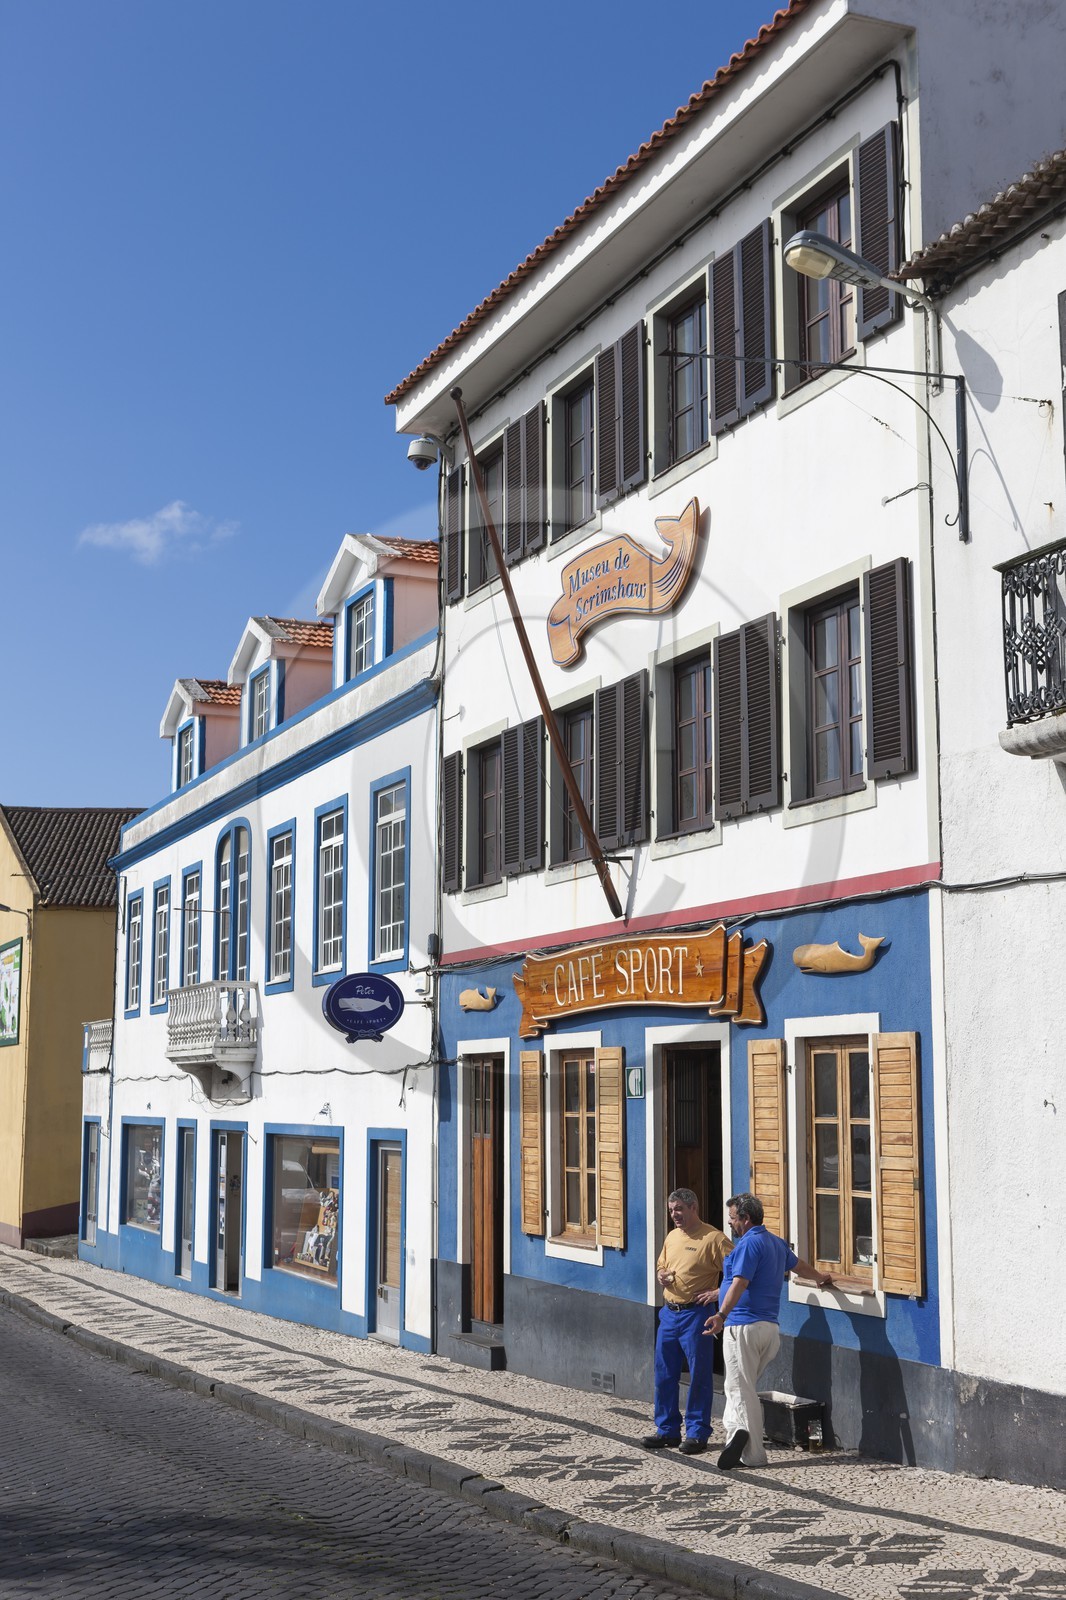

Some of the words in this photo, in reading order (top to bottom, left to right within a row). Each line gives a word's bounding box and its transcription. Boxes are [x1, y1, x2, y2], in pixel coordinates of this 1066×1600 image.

[568, 559, 610, 599] Museu
[614, 548, 630, 570] de
[576, 577, 647, 622] Scrimshaw
[355, 985, 375, 995] Peter
[554, 949, 605, 1006] CAFÉ
[615, 946, 688, 995] SPORT
